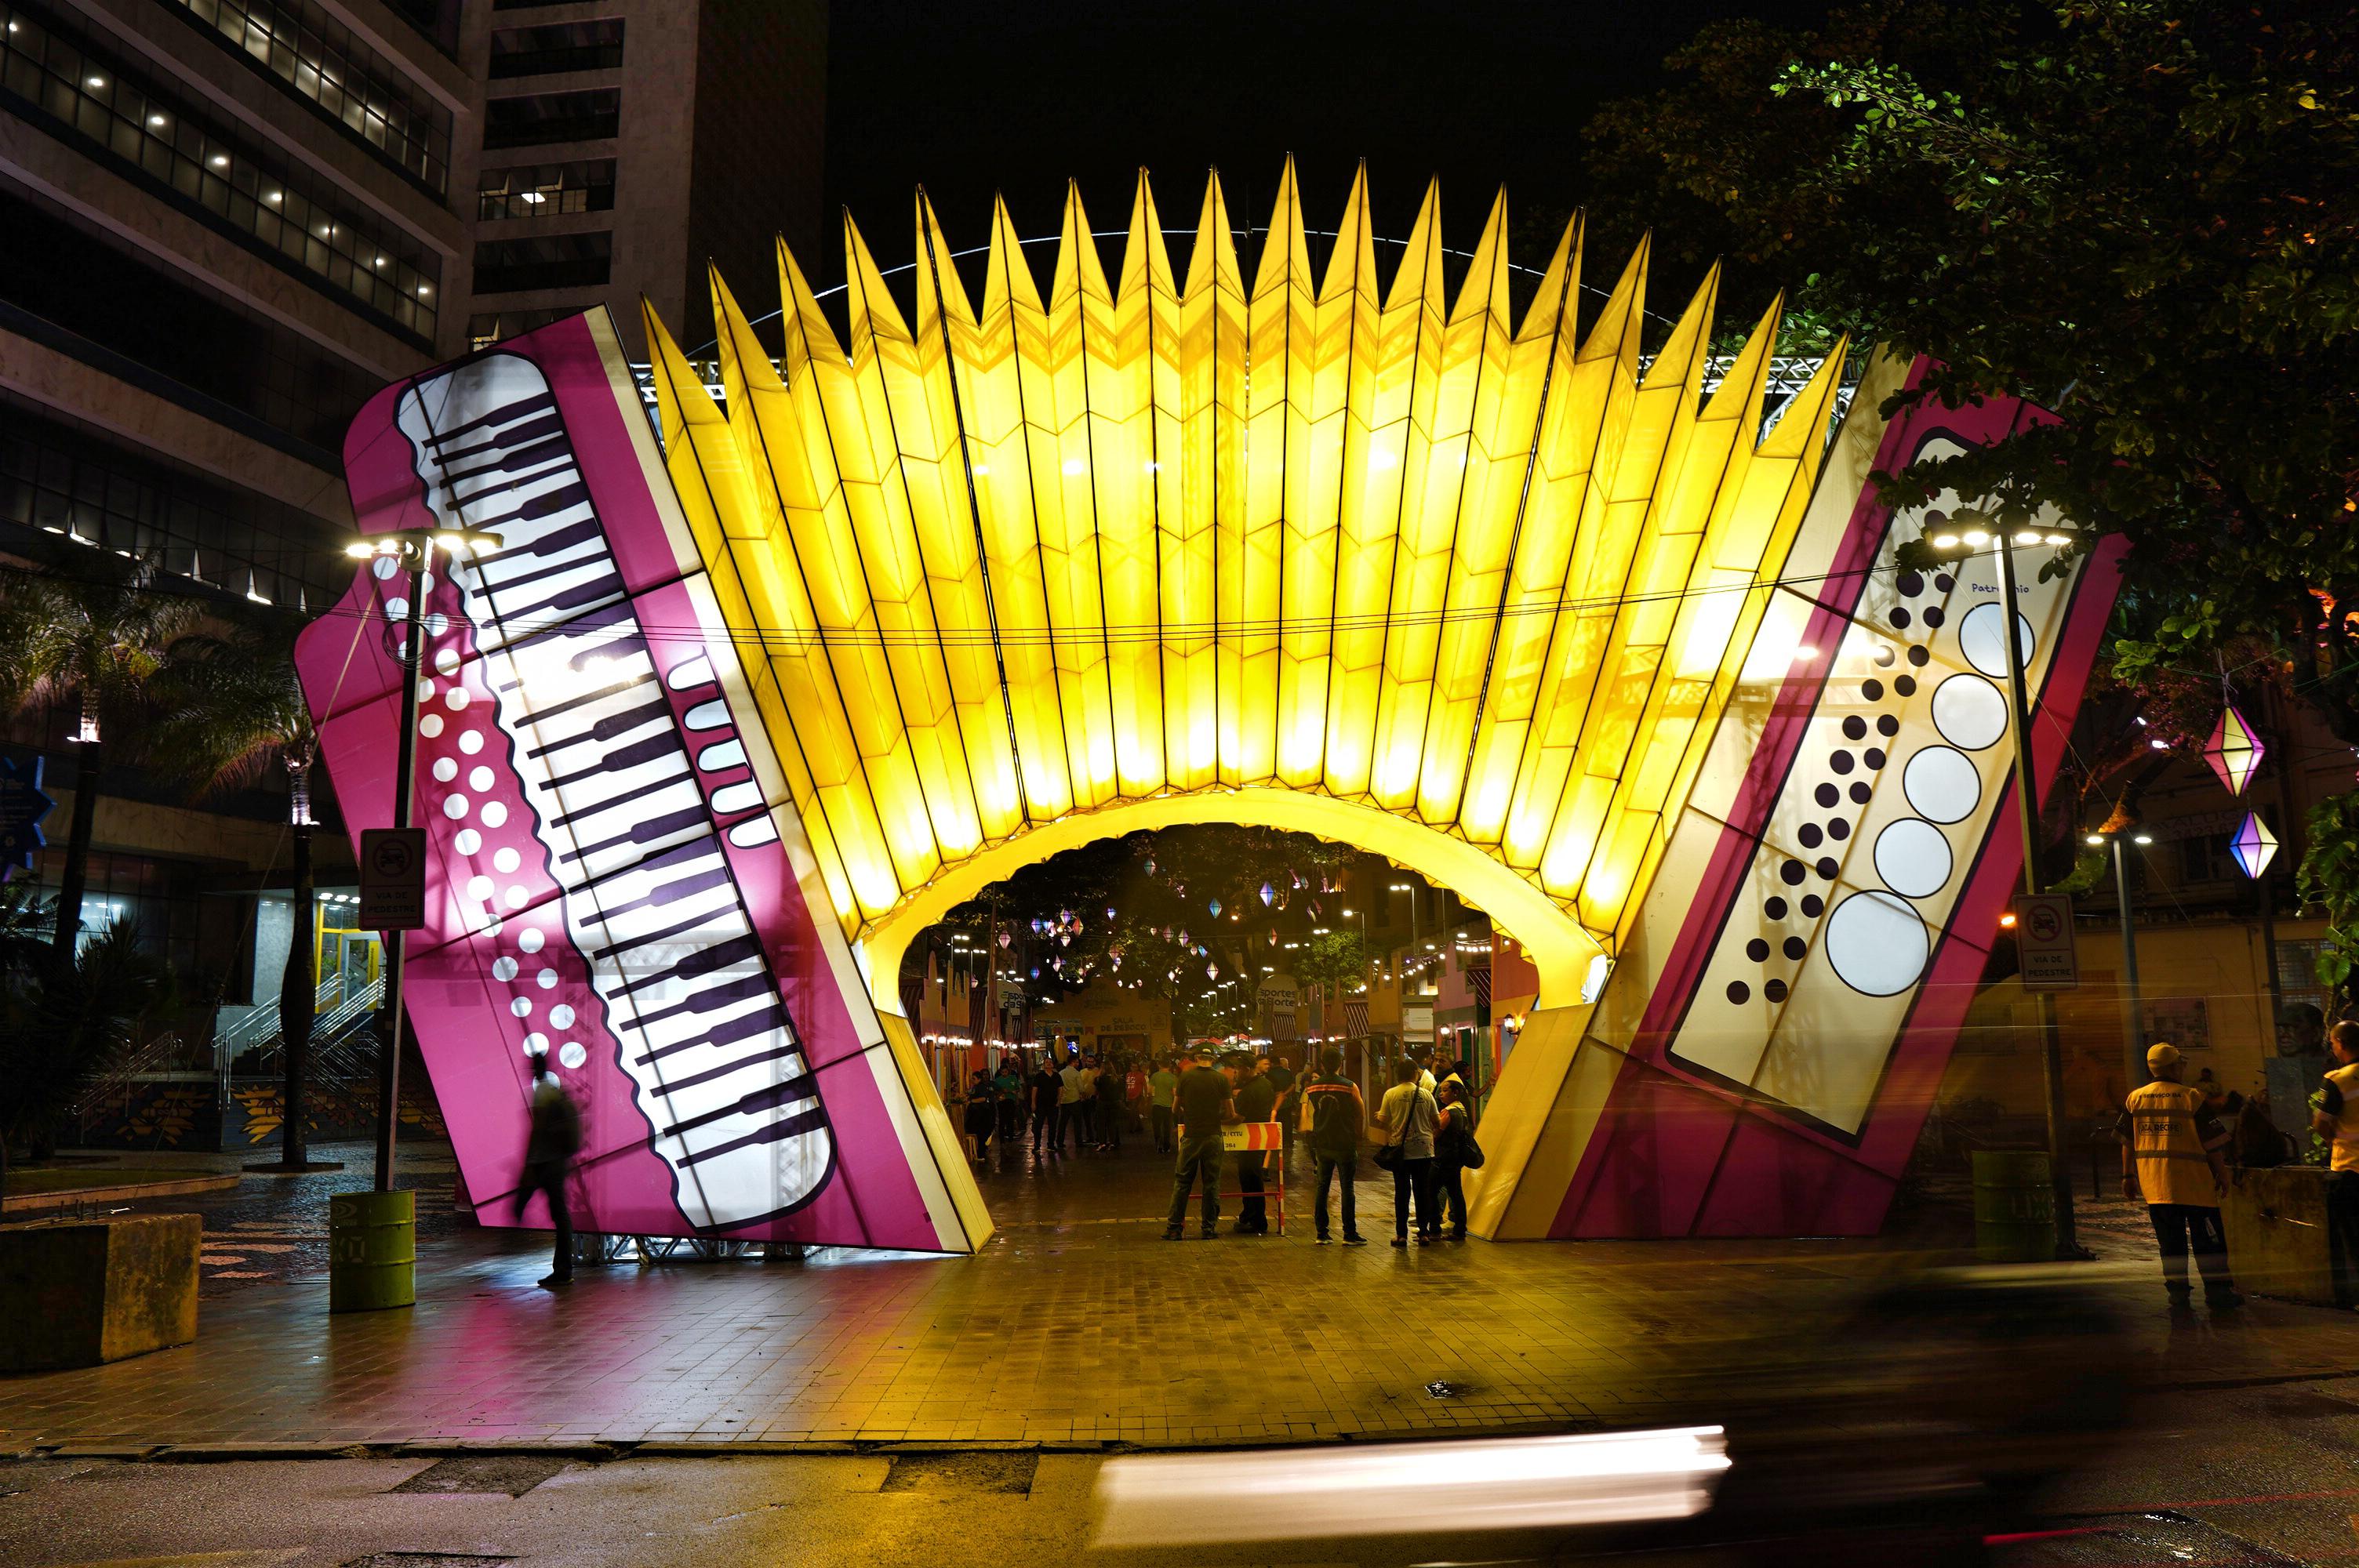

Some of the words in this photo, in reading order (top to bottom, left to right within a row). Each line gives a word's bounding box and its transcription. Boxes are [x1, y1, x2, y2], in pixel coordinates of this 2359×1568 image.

[1972, 583, 2030, 593] Patrnio
[368, 905, 416, 913] PEDESTRE
[2051, 955, 2063, 964] DE
[2028, 968, 2071, 977] PEDESTRE
[2154, 1123, 2179, 1132] RECIFE
